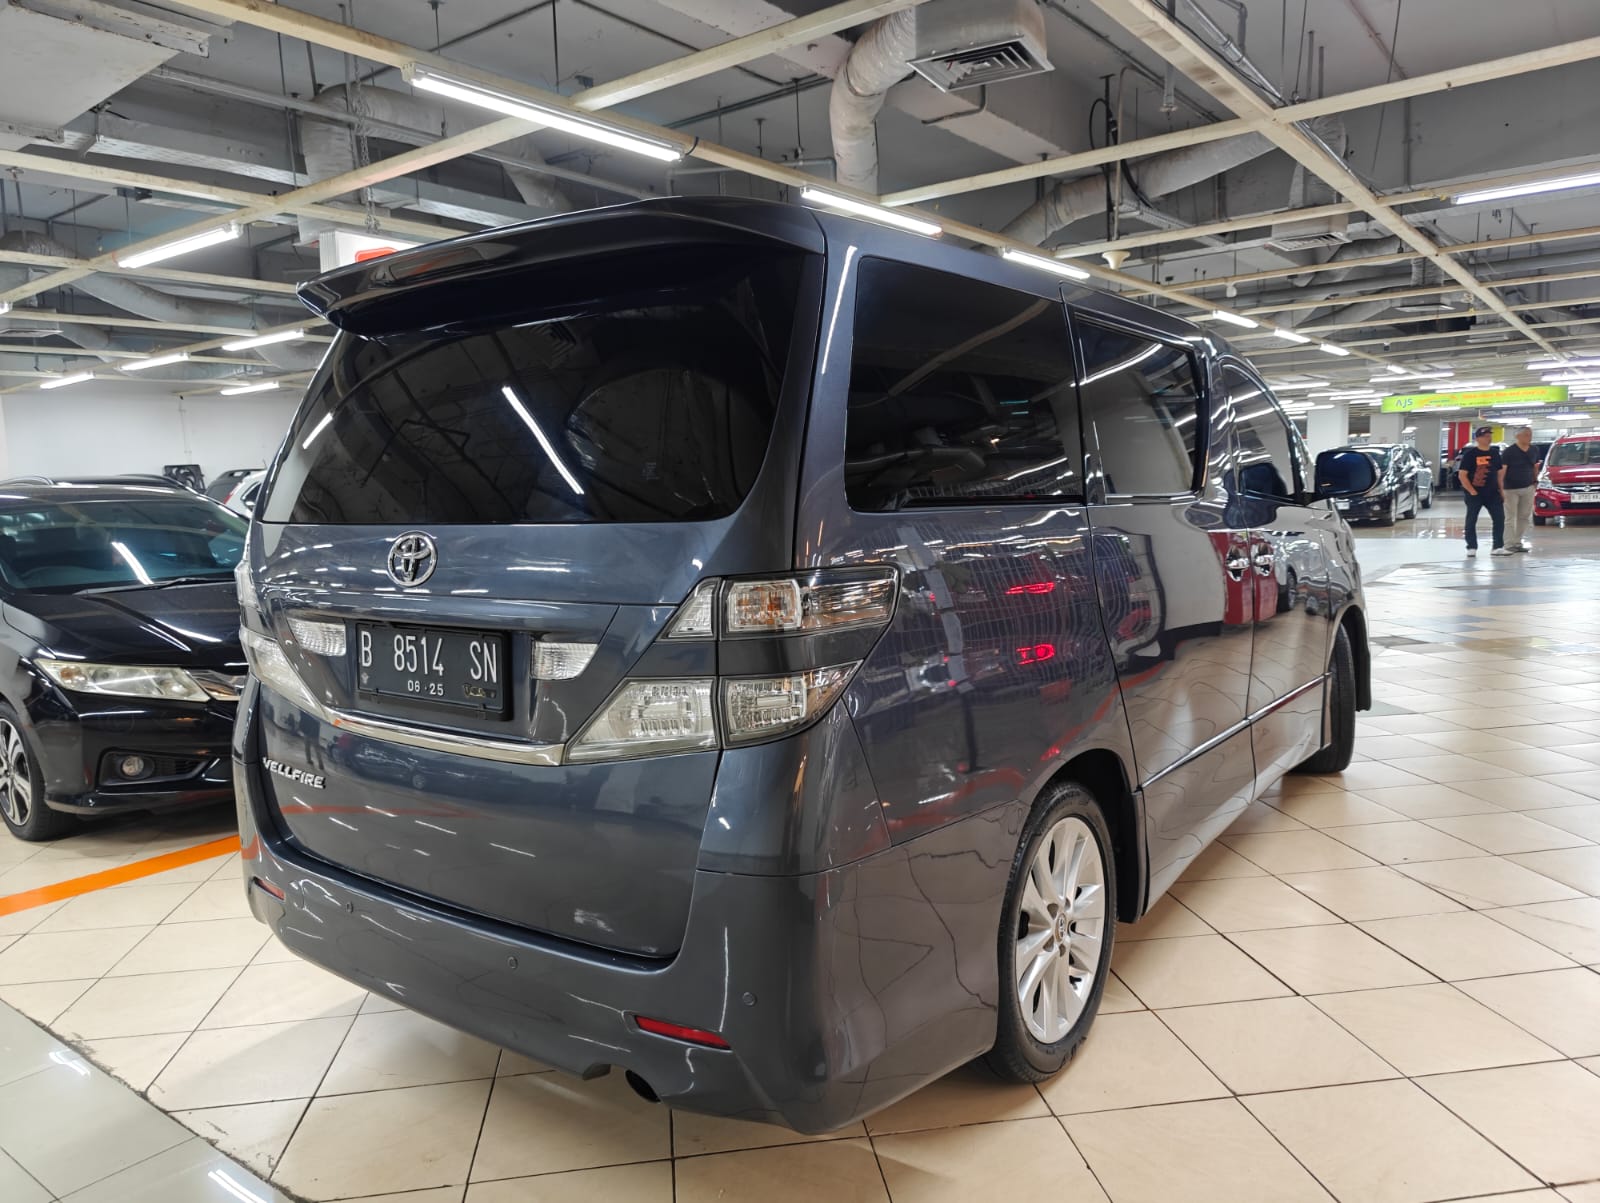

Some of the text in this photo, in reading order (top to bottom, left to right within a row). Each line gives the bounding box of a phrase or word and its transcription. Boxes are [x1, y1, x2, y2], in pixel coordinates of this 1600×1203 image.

[1395, 398, 1413, 408] AJS
[361, 630, 497, 683] B 8514 SN
[262, 756, 325, 789] VELLFIRE
